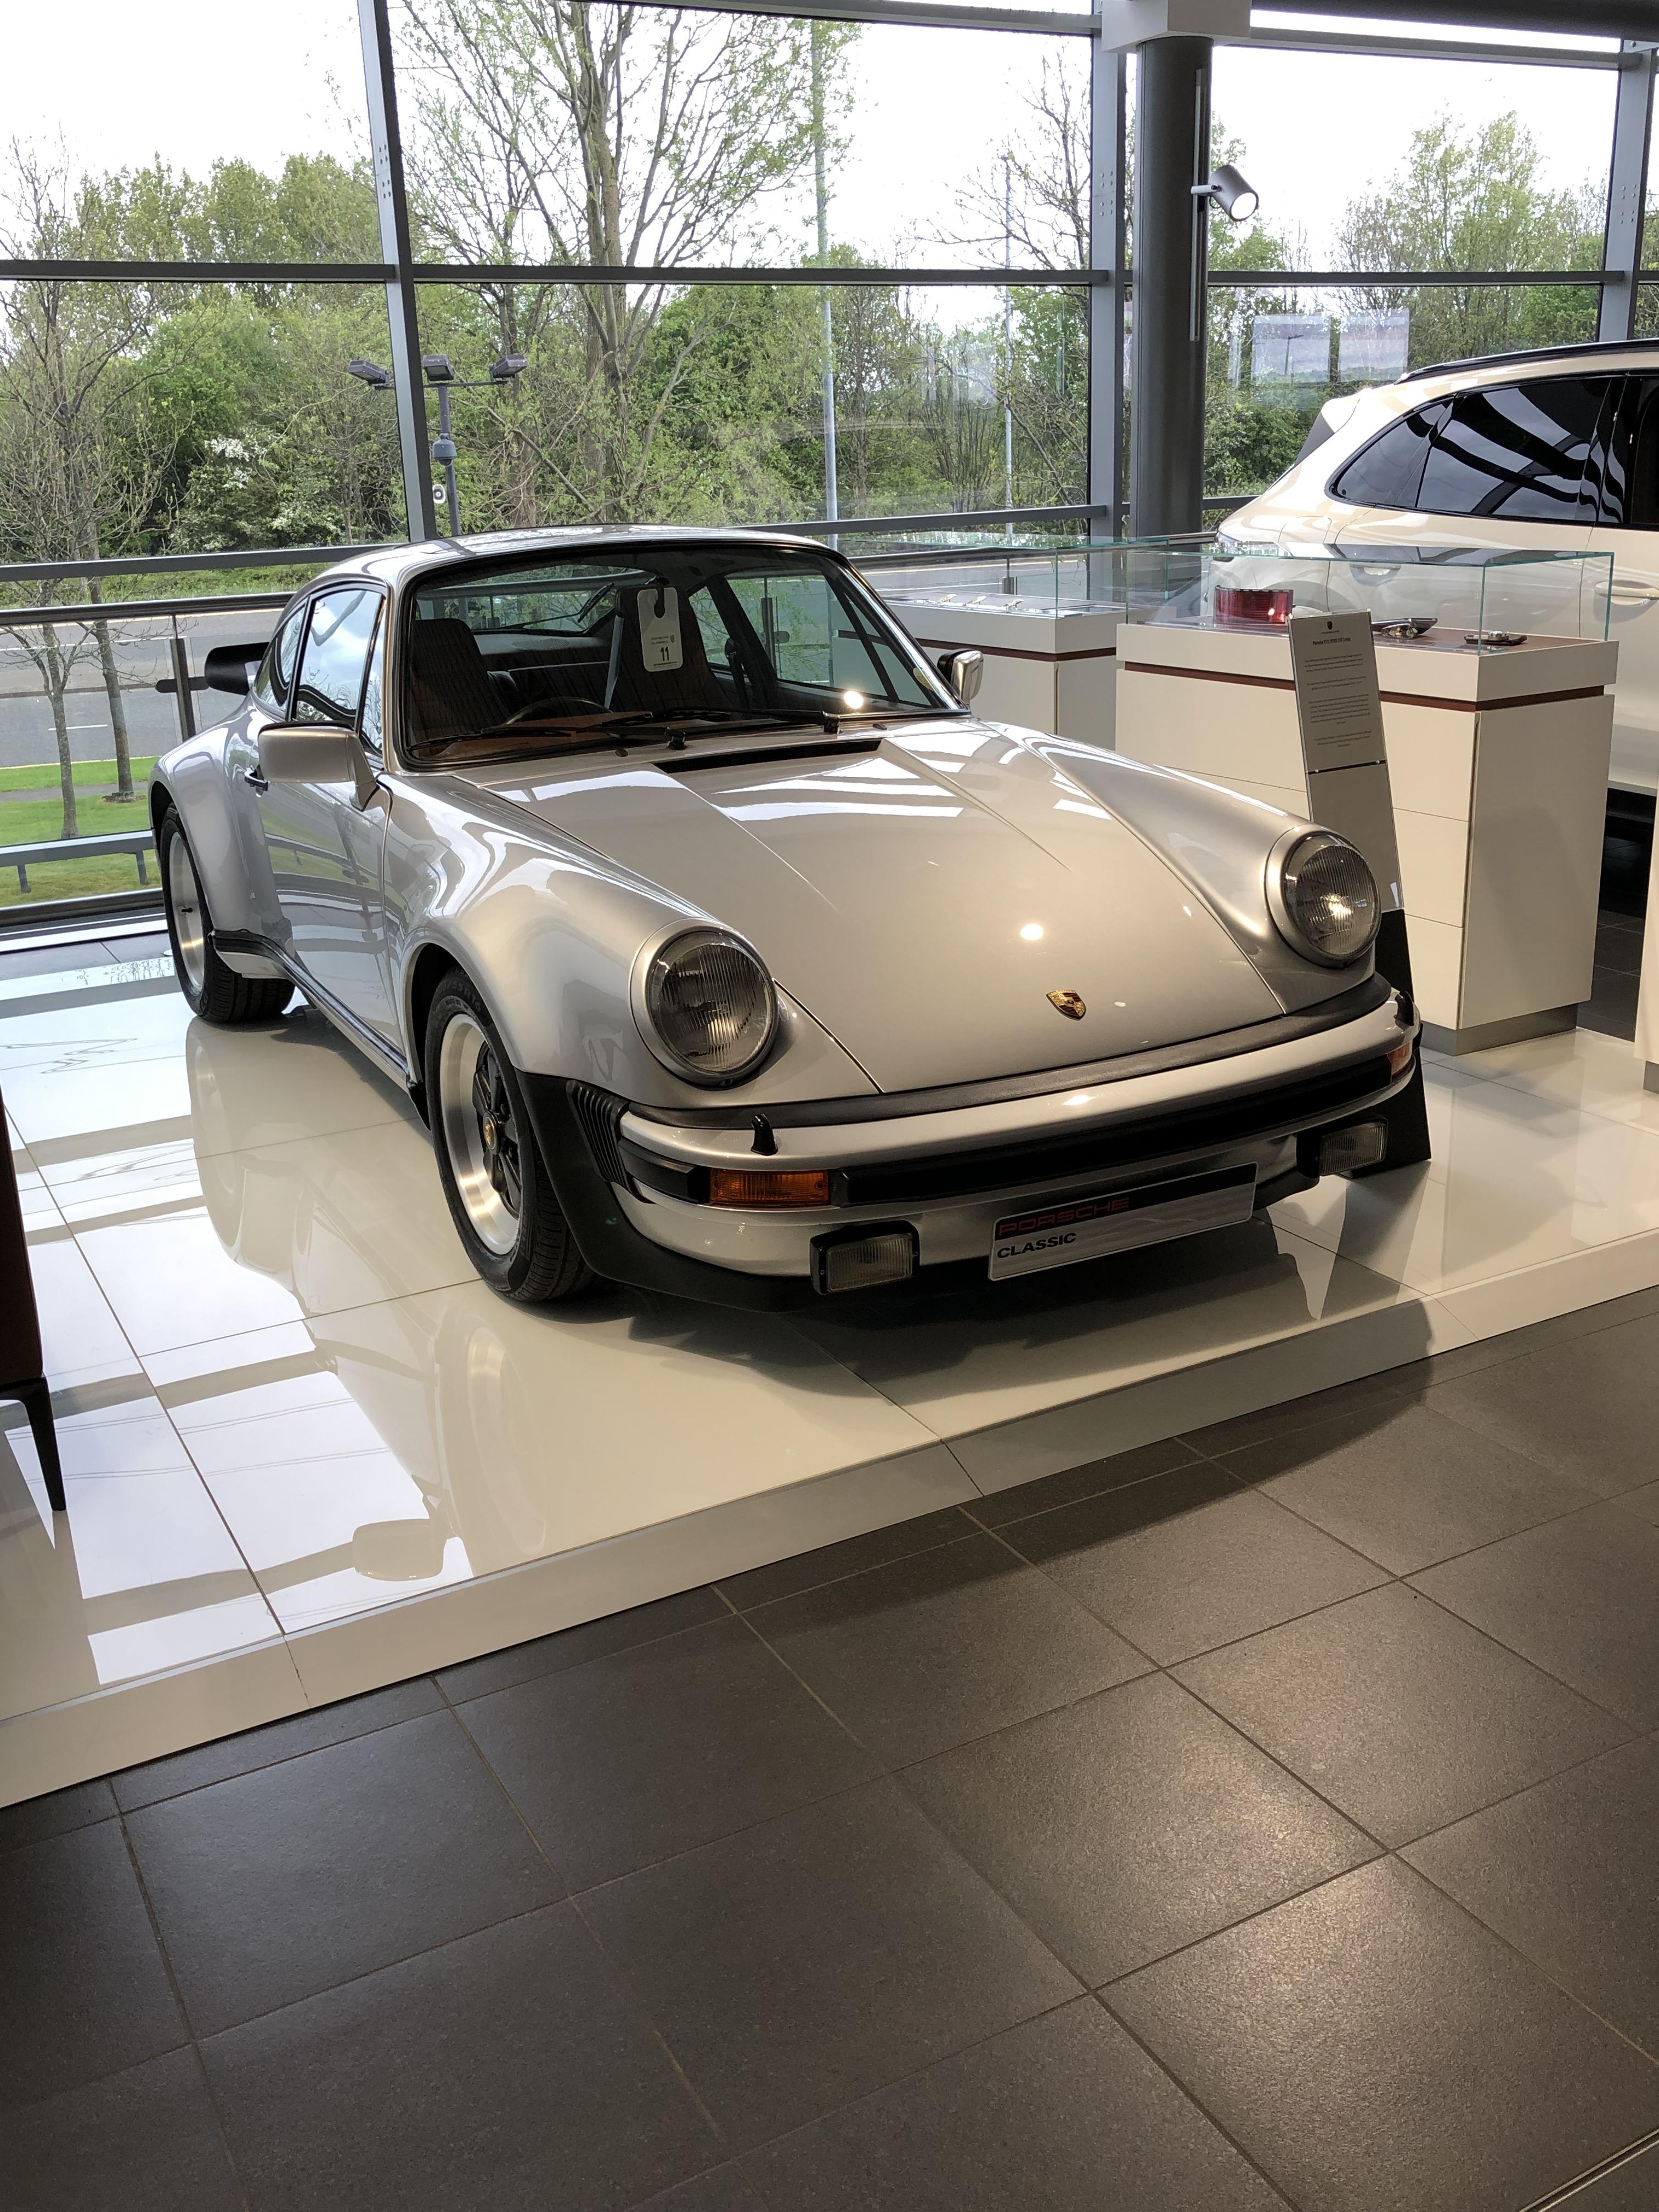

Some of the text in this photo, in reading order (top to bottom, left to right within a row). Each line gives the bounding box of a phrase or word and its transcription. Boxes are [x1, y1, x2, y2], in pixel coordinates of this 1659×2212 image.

[660, 646, 670, 662] 11
[998, 1198, 1130, 1235] PORSCHE
[996, 1232, 1077, 1259] CLASSIC
